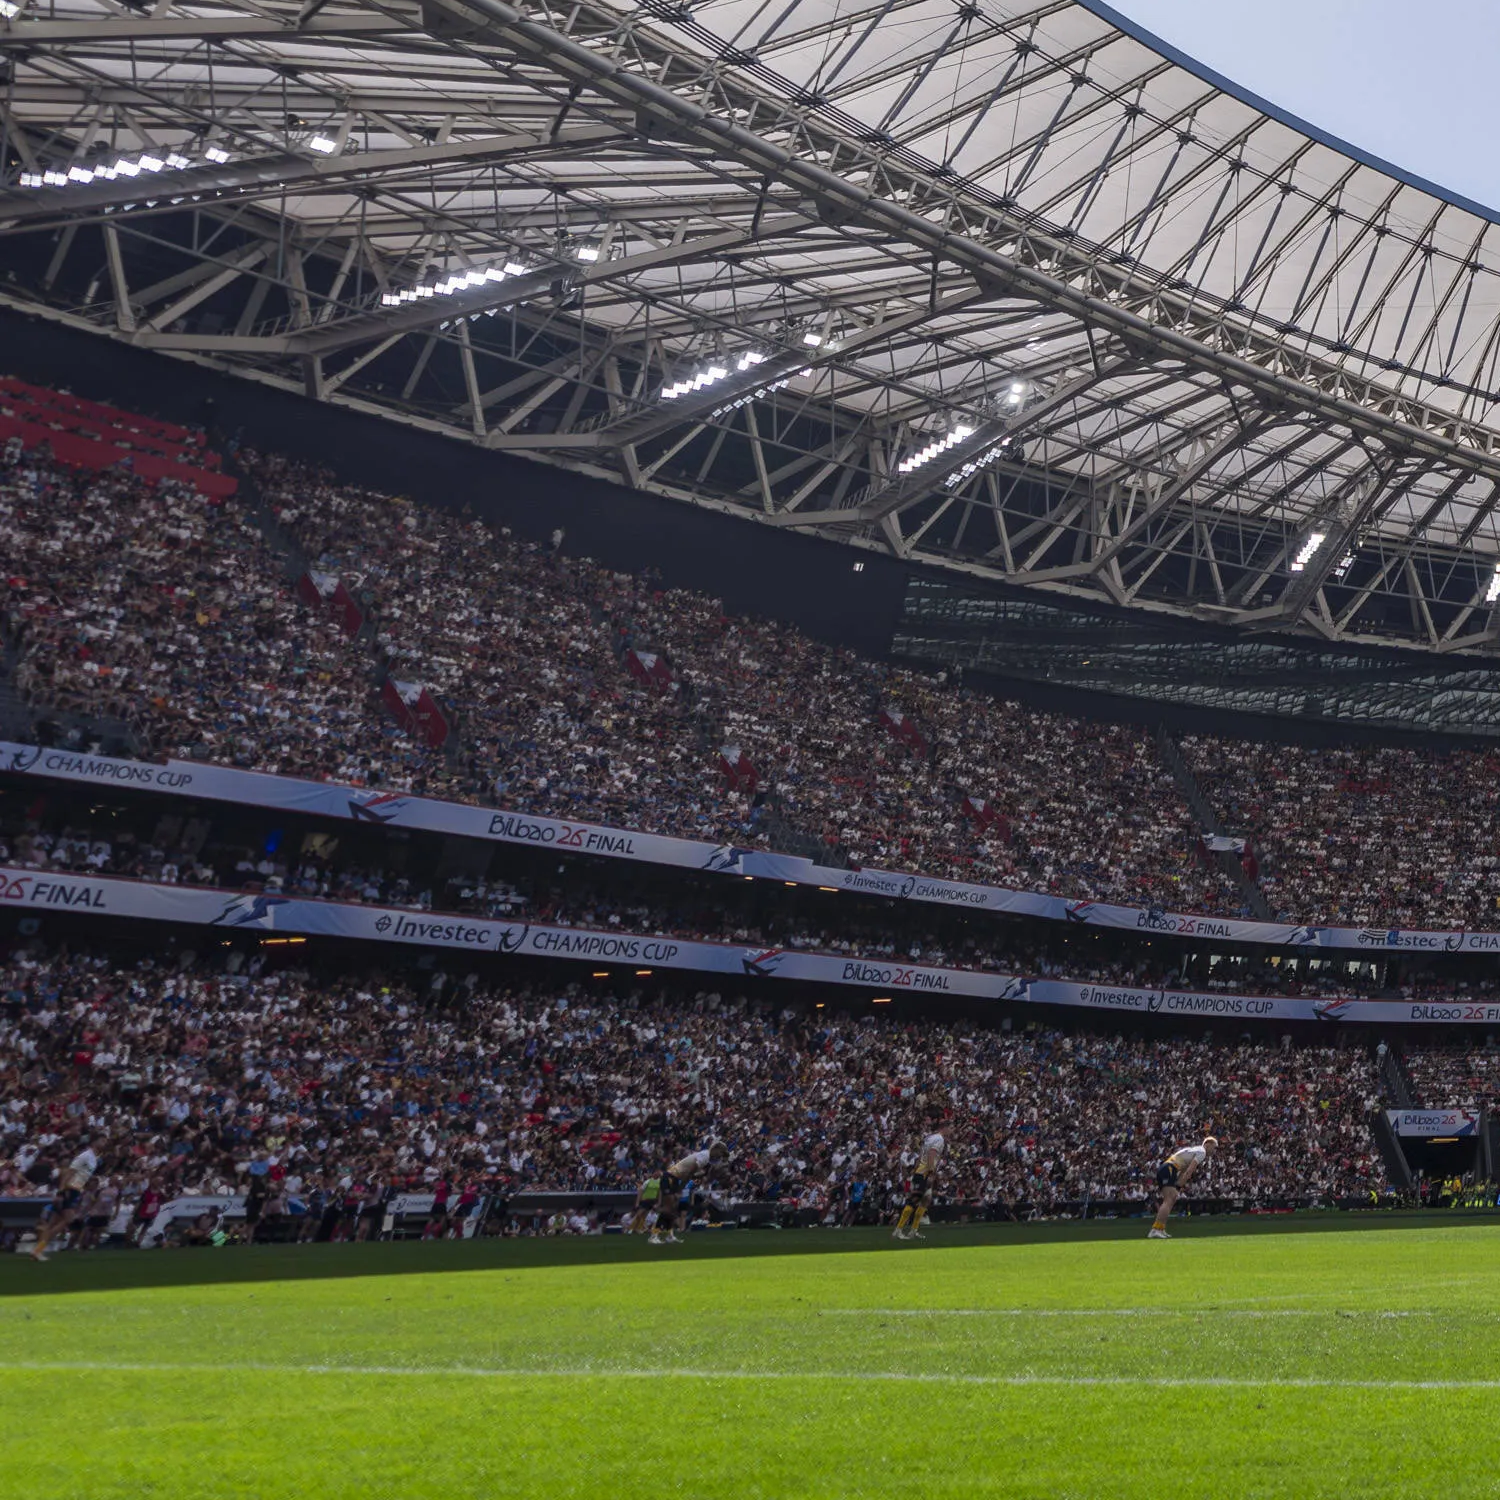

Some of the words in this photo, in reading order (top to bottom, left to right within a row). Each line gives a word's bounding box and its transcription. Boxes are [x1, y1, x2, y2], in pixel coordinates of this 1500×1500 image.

[46, 754, 153, 783] CHAMPIONS
[156, 771, 192, 788] CUP
[488, 813, 555, 842] Bilbao
[556, 825, 588, 847] 26
[585, 833, 635, 855] FINAL
[30, 882, 107, 908] FINAL
[853, 874, 897, 892] Investec
[916, 884, 969, 902] CHAMPIONS
[969, 892, 988, 904] CUP
[393, 915, 490, 944] Investec
[532, 931, 640, 960] CHAMPIONS
[642, 942, 678, 963] CUP
[1178, 918, 1197, 933] 26
[1197, 922, 1232, 937] FINAL
[842, 962, 891, 983] Bilbao
[892, 968, 915, 986] 26
[913, 973, 950, 990] FINAL
[1090, 986, 1143, 1006] Investec
[1167, 995, 1243, 1013] CHAMPIONS
[1245, 1000, 1274, 1015] CUP
[1411, 1005, 1462, 1020] Bilbao
[1463, 1006, 1485, 1020] 26
[1404, 1113, 1441, 1126] Bilbao
[1441, 1113, 1456, 1125] 26
